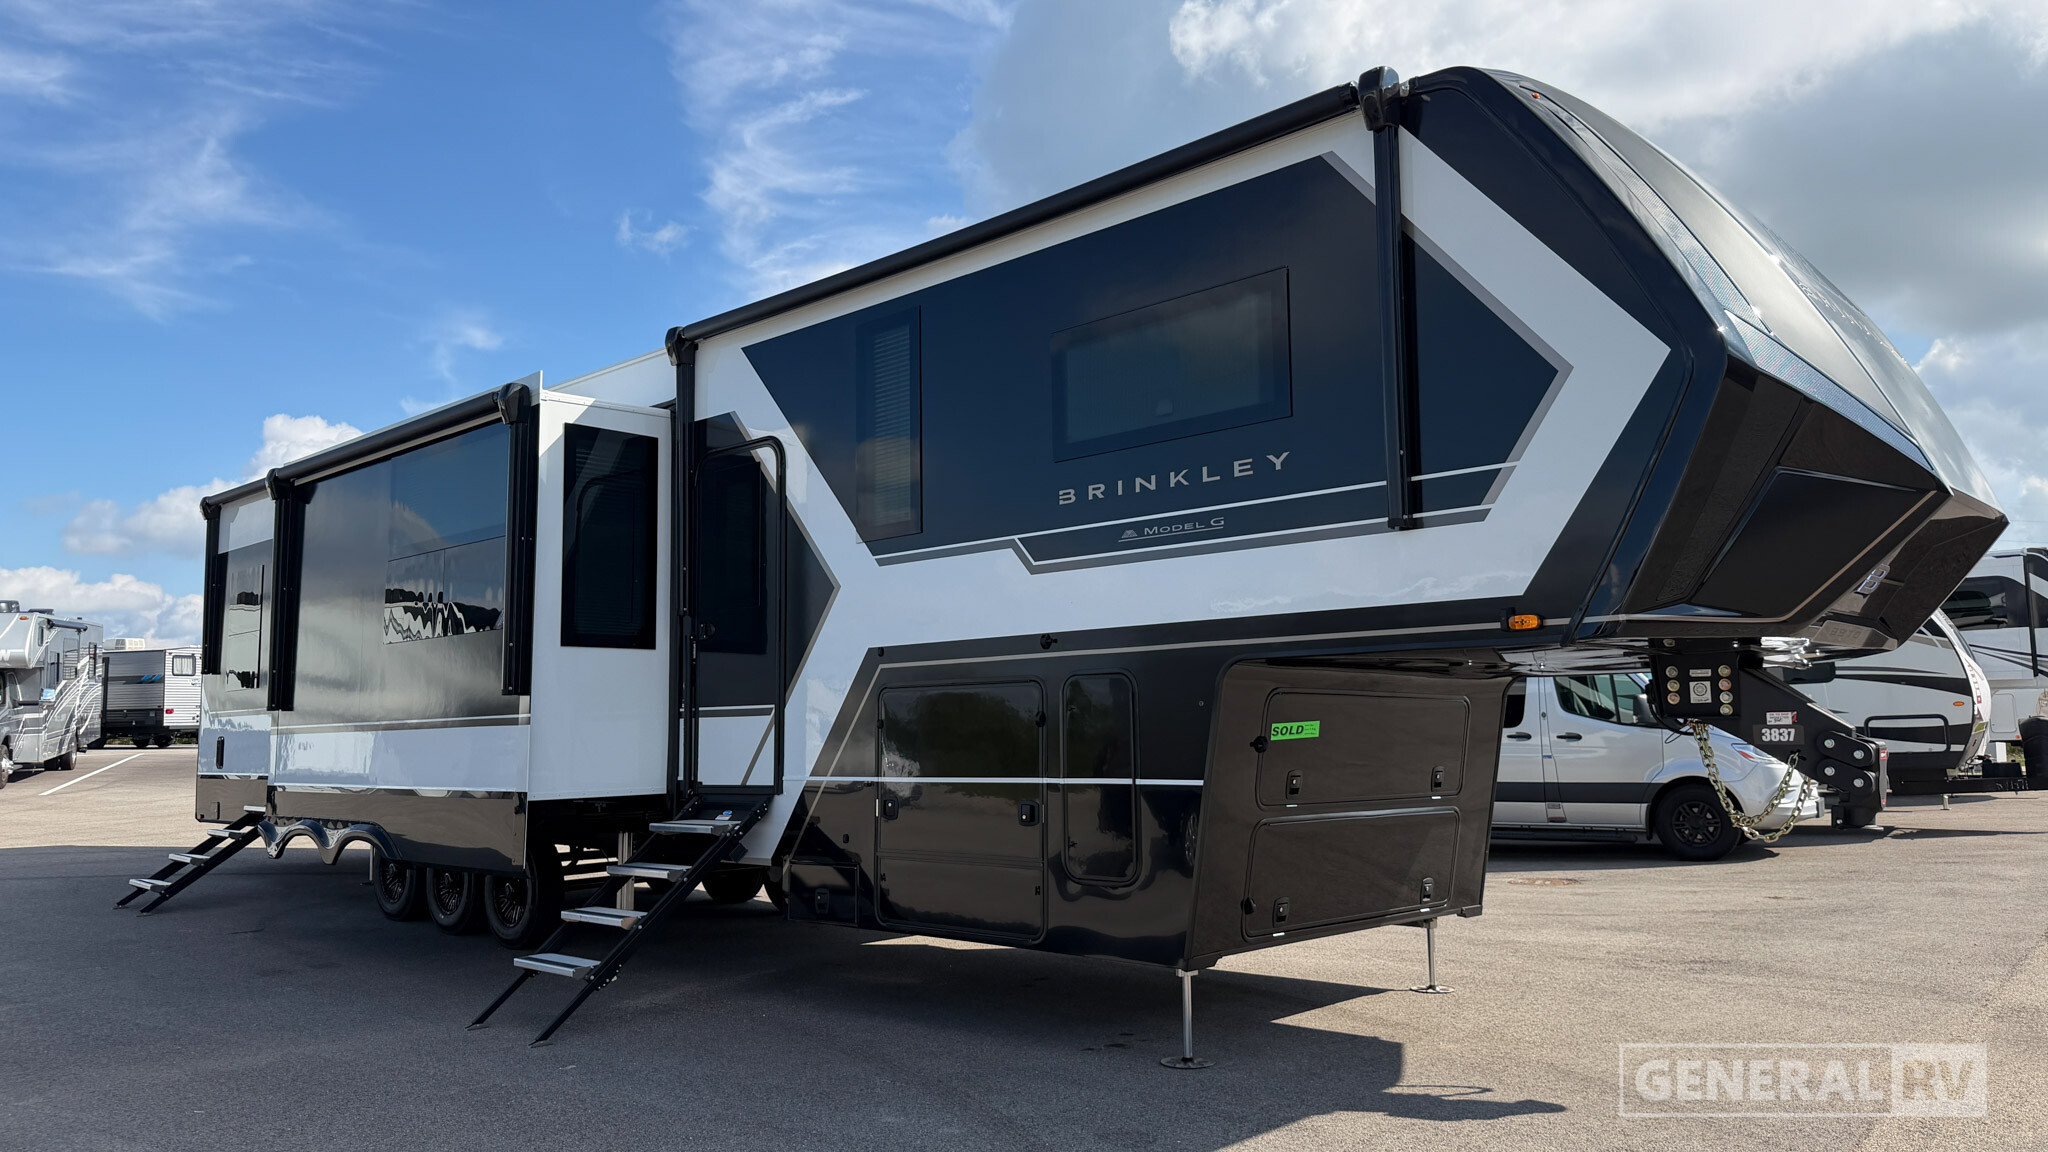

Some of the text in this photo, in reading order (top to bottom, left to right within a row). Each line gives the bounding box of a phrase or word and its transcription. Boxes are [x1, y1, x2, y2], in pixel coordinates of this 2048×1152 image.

[1058, 451, 1291, 506] BRINKLEY
[1210, 516, 1226, 528] G
[1271, 725, 1304, 737] SOLD
[1761, 728, 1796, 742] 3837
